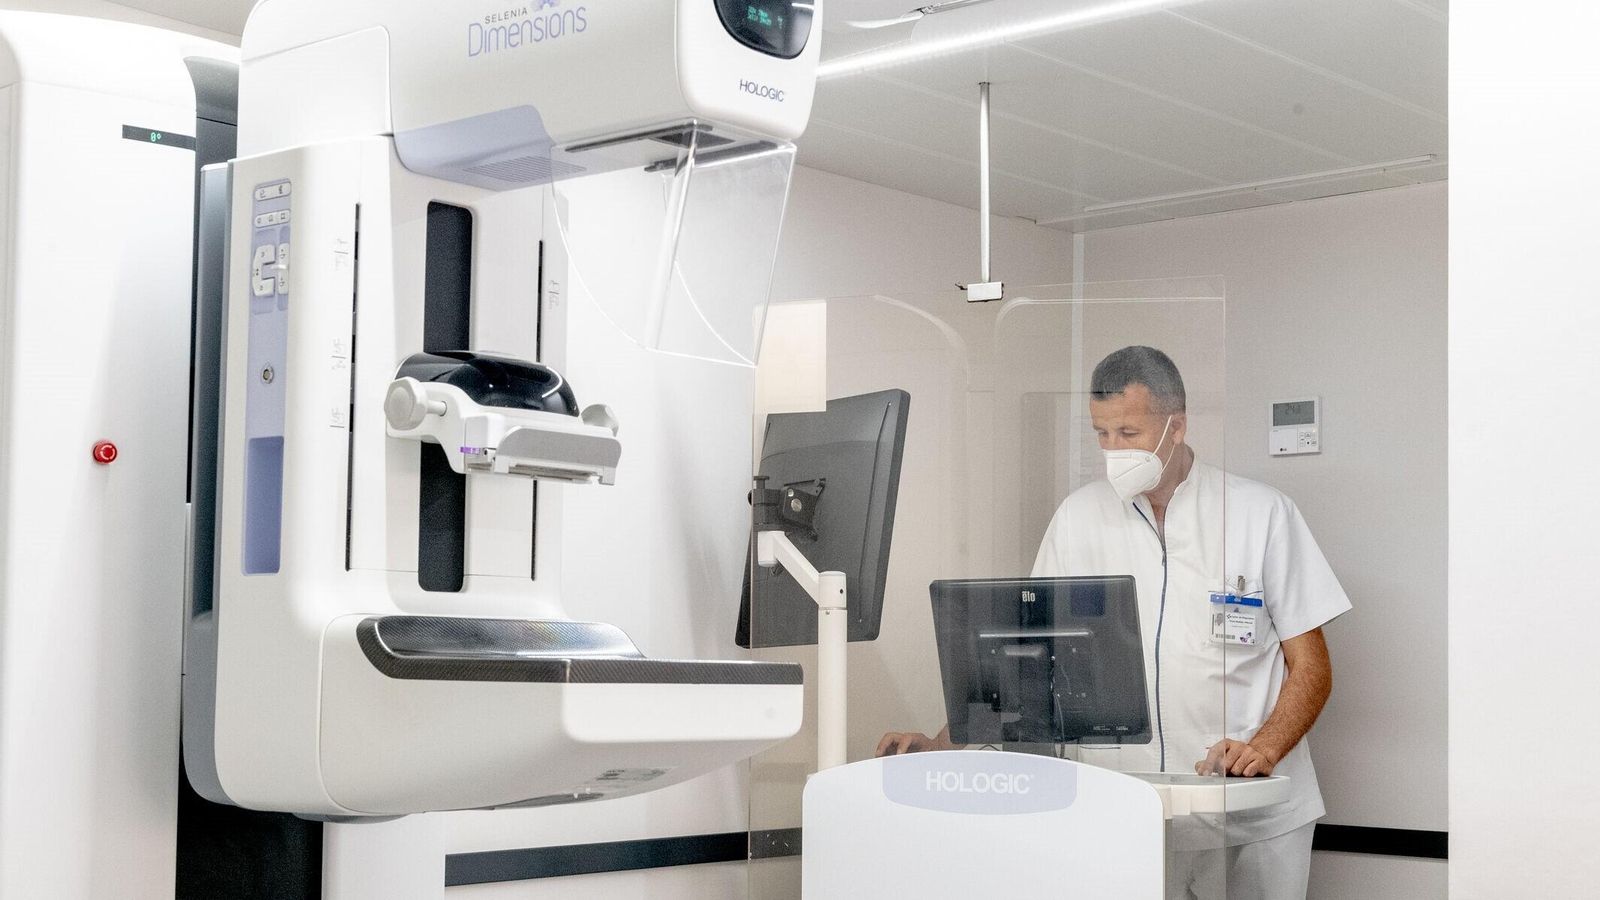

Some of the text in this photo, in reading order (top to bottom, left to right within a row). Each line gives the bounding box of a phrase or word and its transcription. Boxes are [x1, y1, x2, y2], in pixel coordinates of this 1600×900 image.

[484, 7, 528, 25] SELENIA
[468, 6, 587, 57] Dimensions
[739, 79, 785, 102] HOLOGIC
[925, 770, 1031, 794] HOLOGIC
